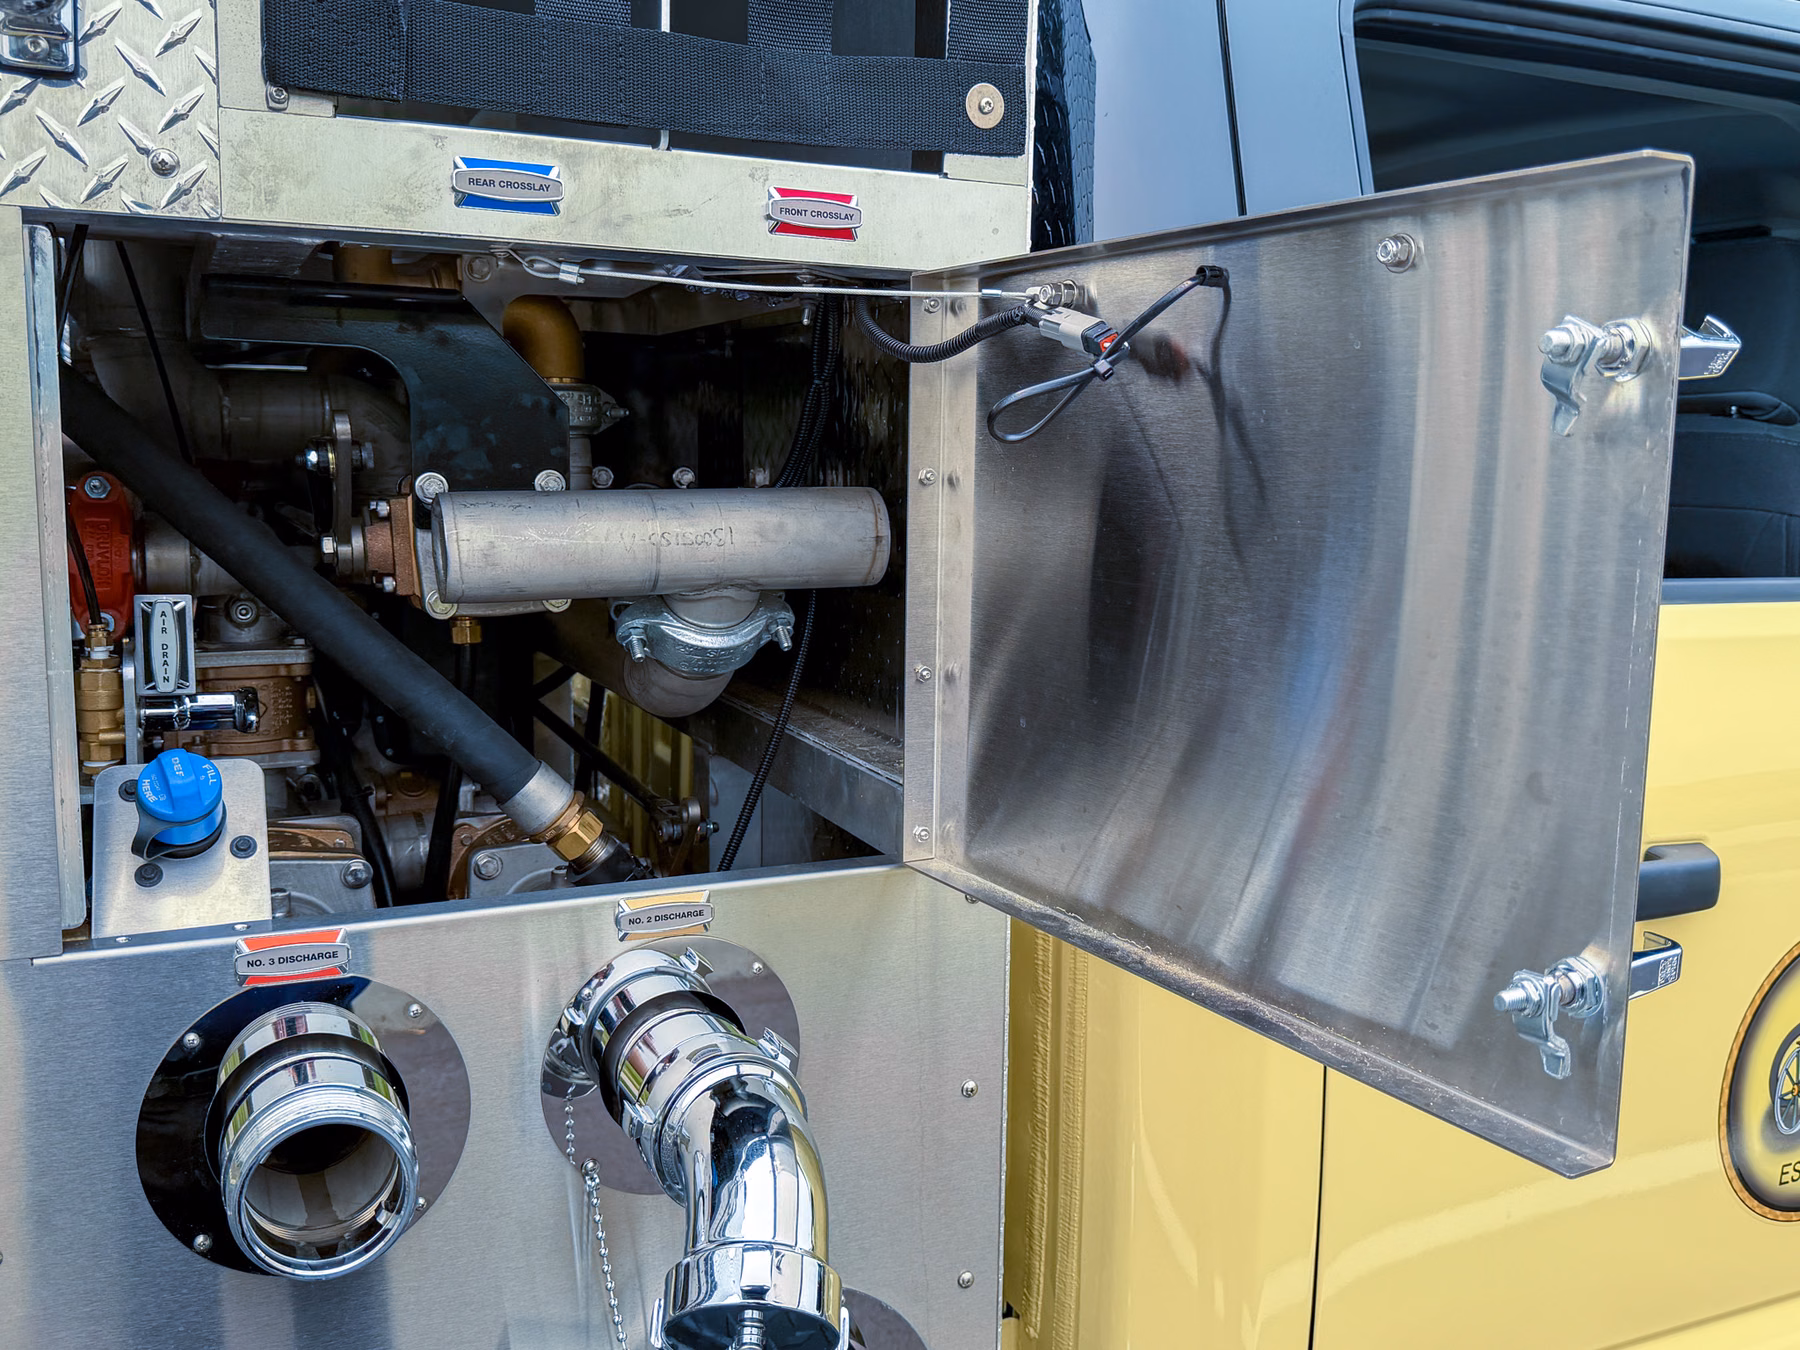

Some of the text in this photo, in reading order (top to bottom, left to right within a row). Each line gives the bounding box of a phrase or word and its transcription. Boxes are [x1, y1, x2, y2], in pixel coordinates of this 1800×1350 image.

[468, 177, 551, 192] REAR CROSSLAY
[779, 207, 855, 221] FRONT CROSSLAY
[160, 610, 170, 684] AIR DRAIN
[171, 757, 184, 777] DEF
[202, 763, 217, 786] FILL
[142, 779, 158, 803] HERE
[628, 917, 644, 926] NO.
[654, 909, 705, 922] DISCHARGE
[246, 950, 340, 969] NO. 3 DISCHARGE
